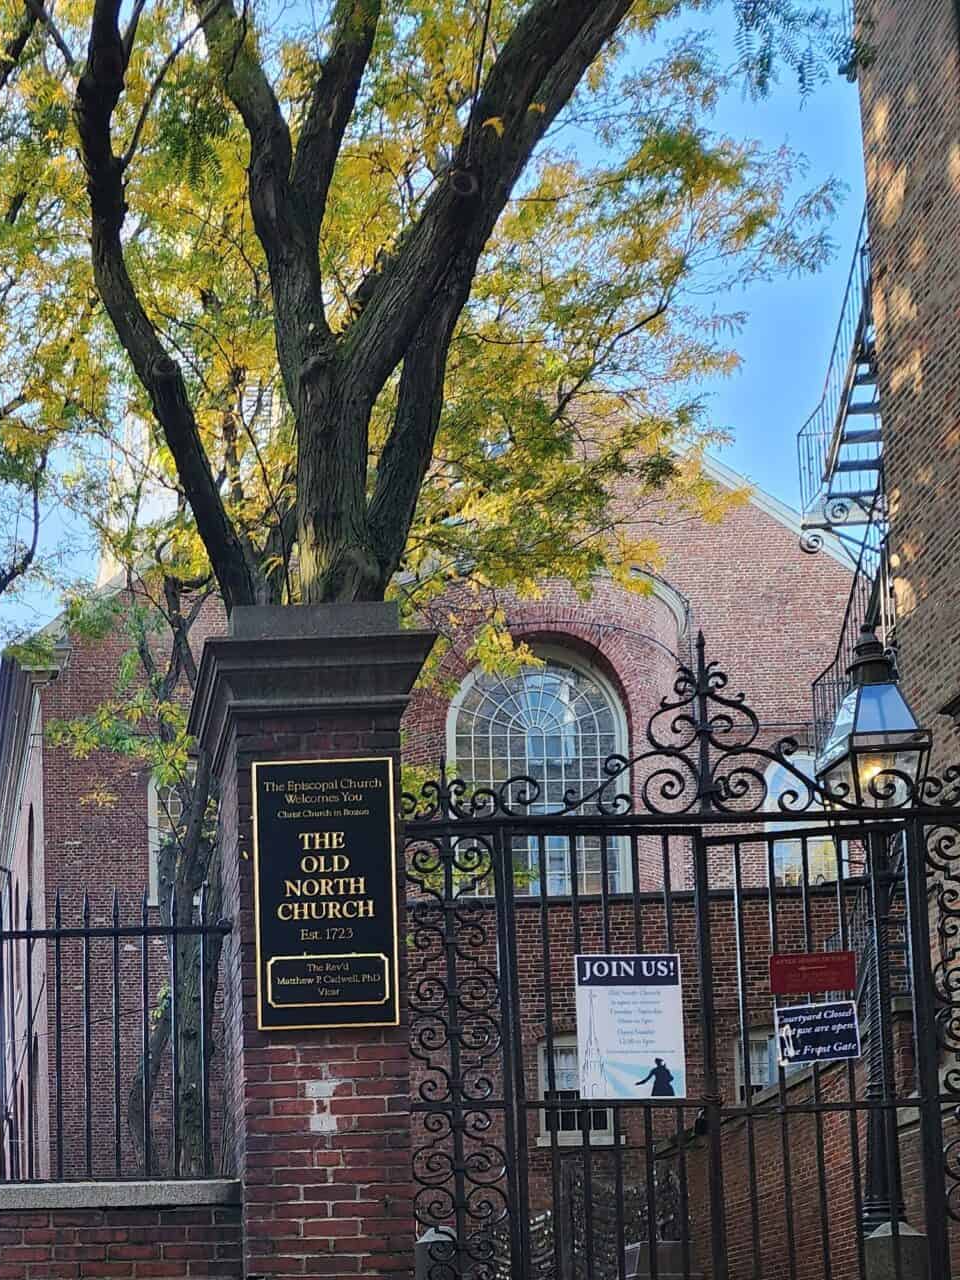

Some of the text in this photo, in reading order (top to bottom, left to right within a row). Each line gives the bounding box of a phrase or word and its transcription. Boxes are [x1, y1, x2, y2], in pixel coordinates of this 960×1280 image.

[264, 777, 382, 792] The Episcopal Church
[285, 791, 363, 804] Welcomes You
[298, 831, 346, 850] THE
[300, 854, 350, 873] OLD
[283, 876, 367, 897] NORTH
[277, 899, 376, 921] CHURCH
[300, 927, 354, 941] Est. 1723
[306, 963, 324, 972] The
[582, 960, 675, 982] JOIN US!
[832, 1042, 857, 1052] Gate
